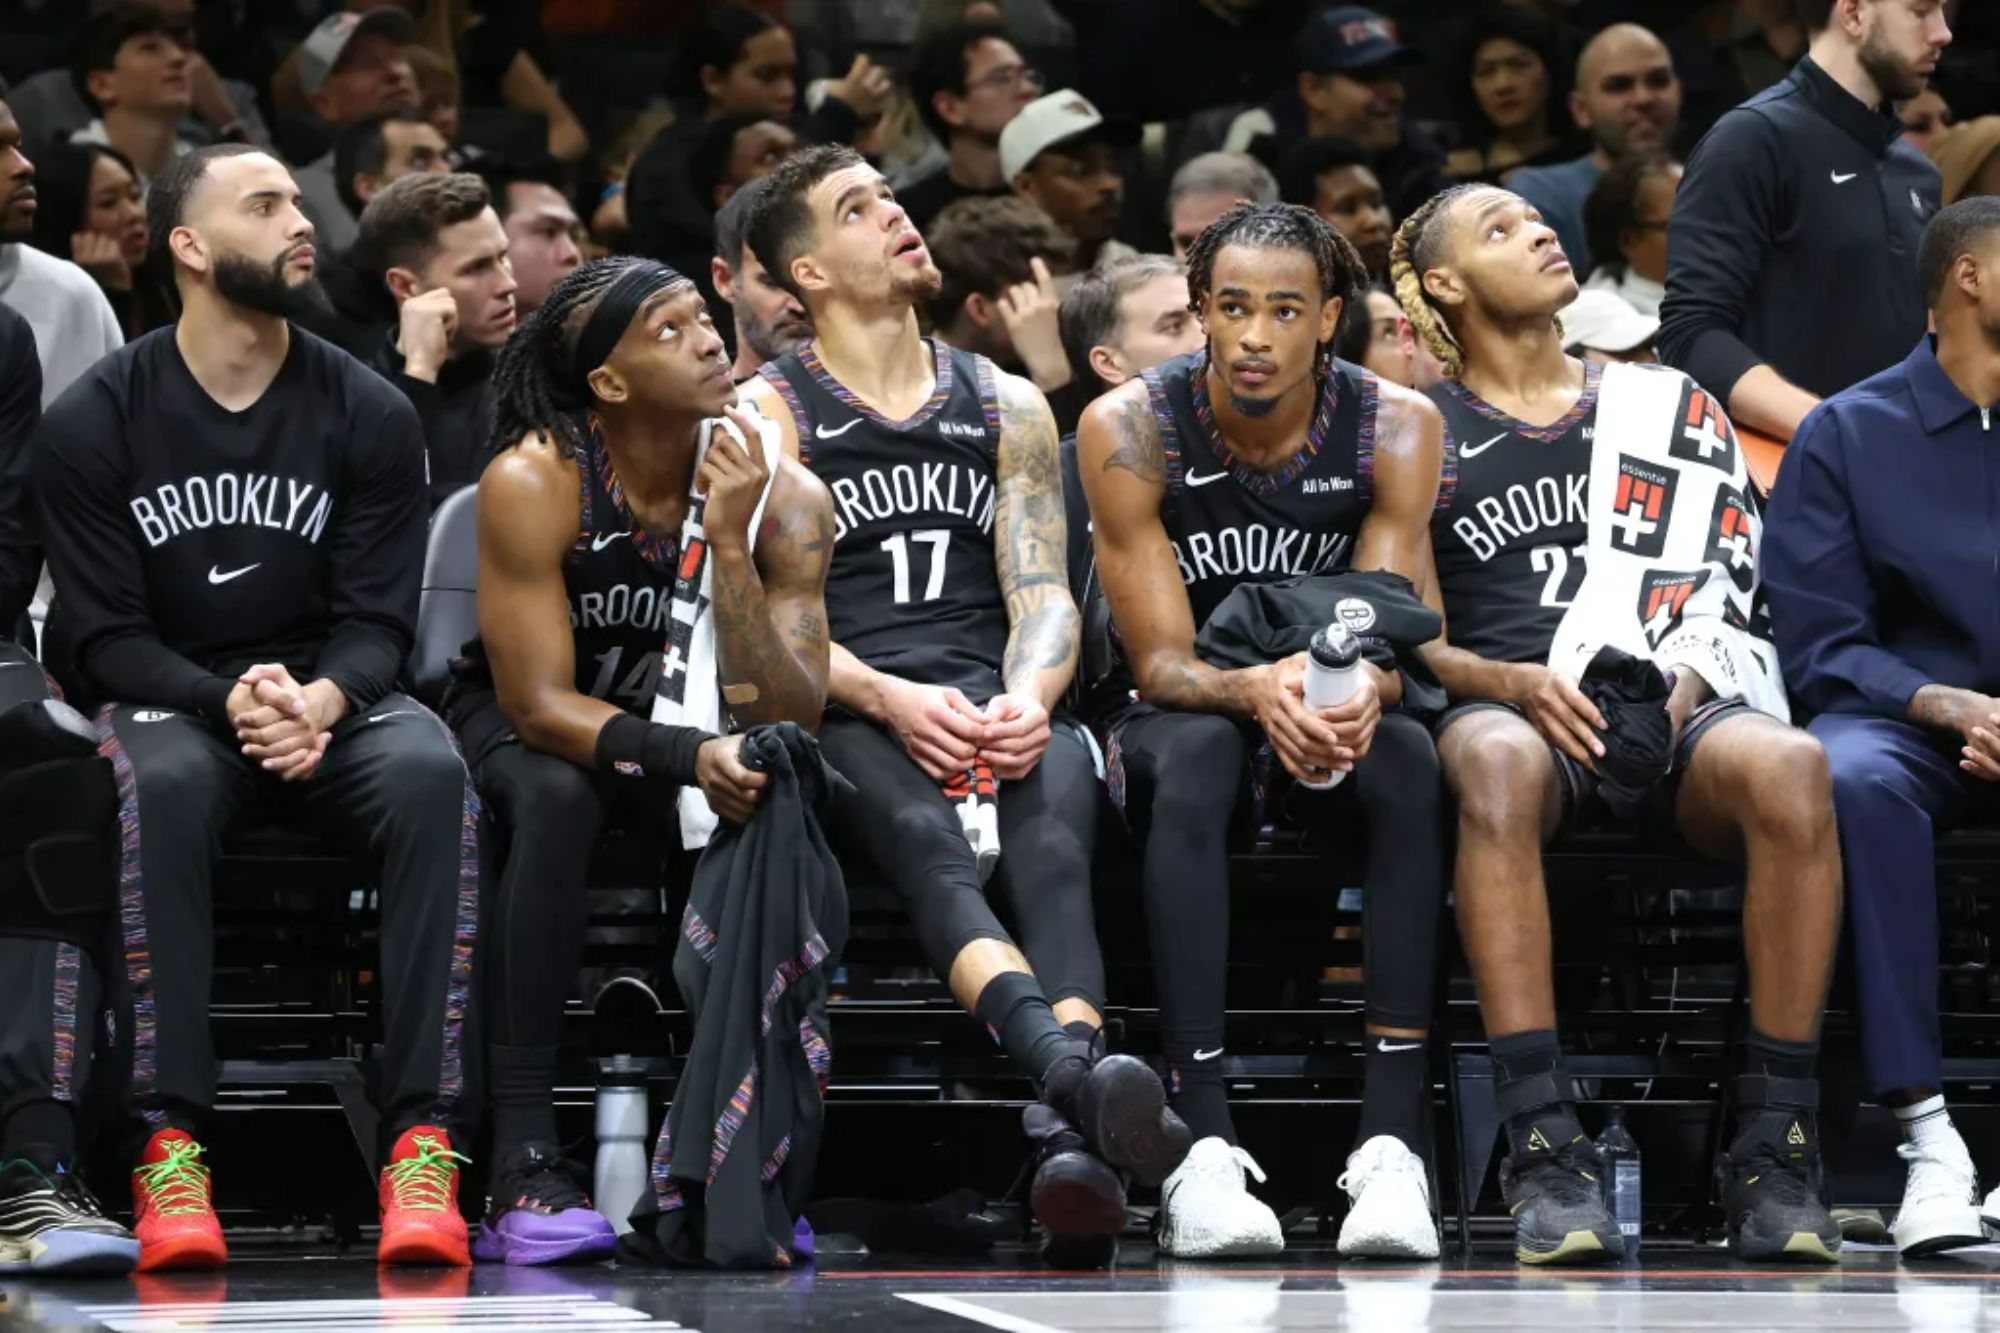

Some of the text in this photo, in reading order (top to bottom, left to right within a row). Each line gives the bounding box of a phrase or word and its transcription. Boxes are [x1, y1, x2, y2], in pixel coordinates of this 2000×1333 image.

[129, 472, 334, 547] BROOKLYN
[1452, 473, 1588, 562] BROOK
[880, 528, 951, 604] 17
[590, 645, 662, 709] 14
